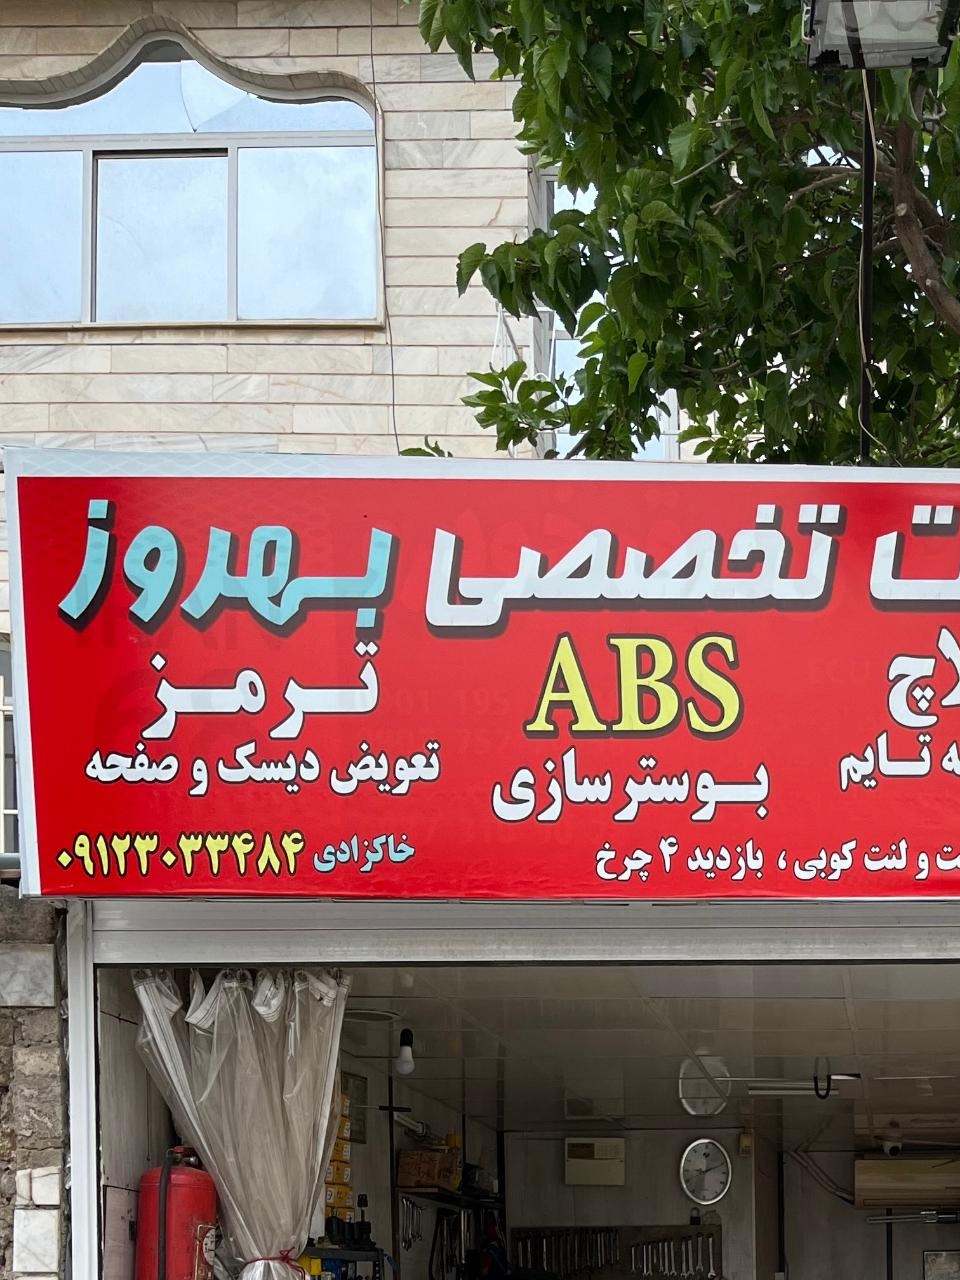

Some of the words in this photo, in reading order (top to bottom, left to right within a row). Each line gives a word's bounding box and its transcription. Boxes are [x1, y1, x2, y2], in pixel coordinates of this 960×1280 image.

[57, 498, 394, 629] بهروز
[424, 502, 842, 628] تخصصی
[141, 639, 381, 740] ترمز
[525, 635, 741, 734] ABS
[84, 741, 180, 783] صفحه
[188, 758, 209, 796] و
[216, 741, 321, 794] دیسک
[329, 741, 441, 795] تعویض
[839, 731, 933, 791] تایم
[56, 831, 305, 876] ۰۹۱۲۳۰۳۳۴۸۴
[312, 833, 416, 873] خاکزادی
[595, 841, 654, 883] چرخ
[658, 835, 680, 874] ۴
[686, 838, 765, 881] بازدید
[862, 837, 909, 872] لنت
[914, 851, 930, 881] و
